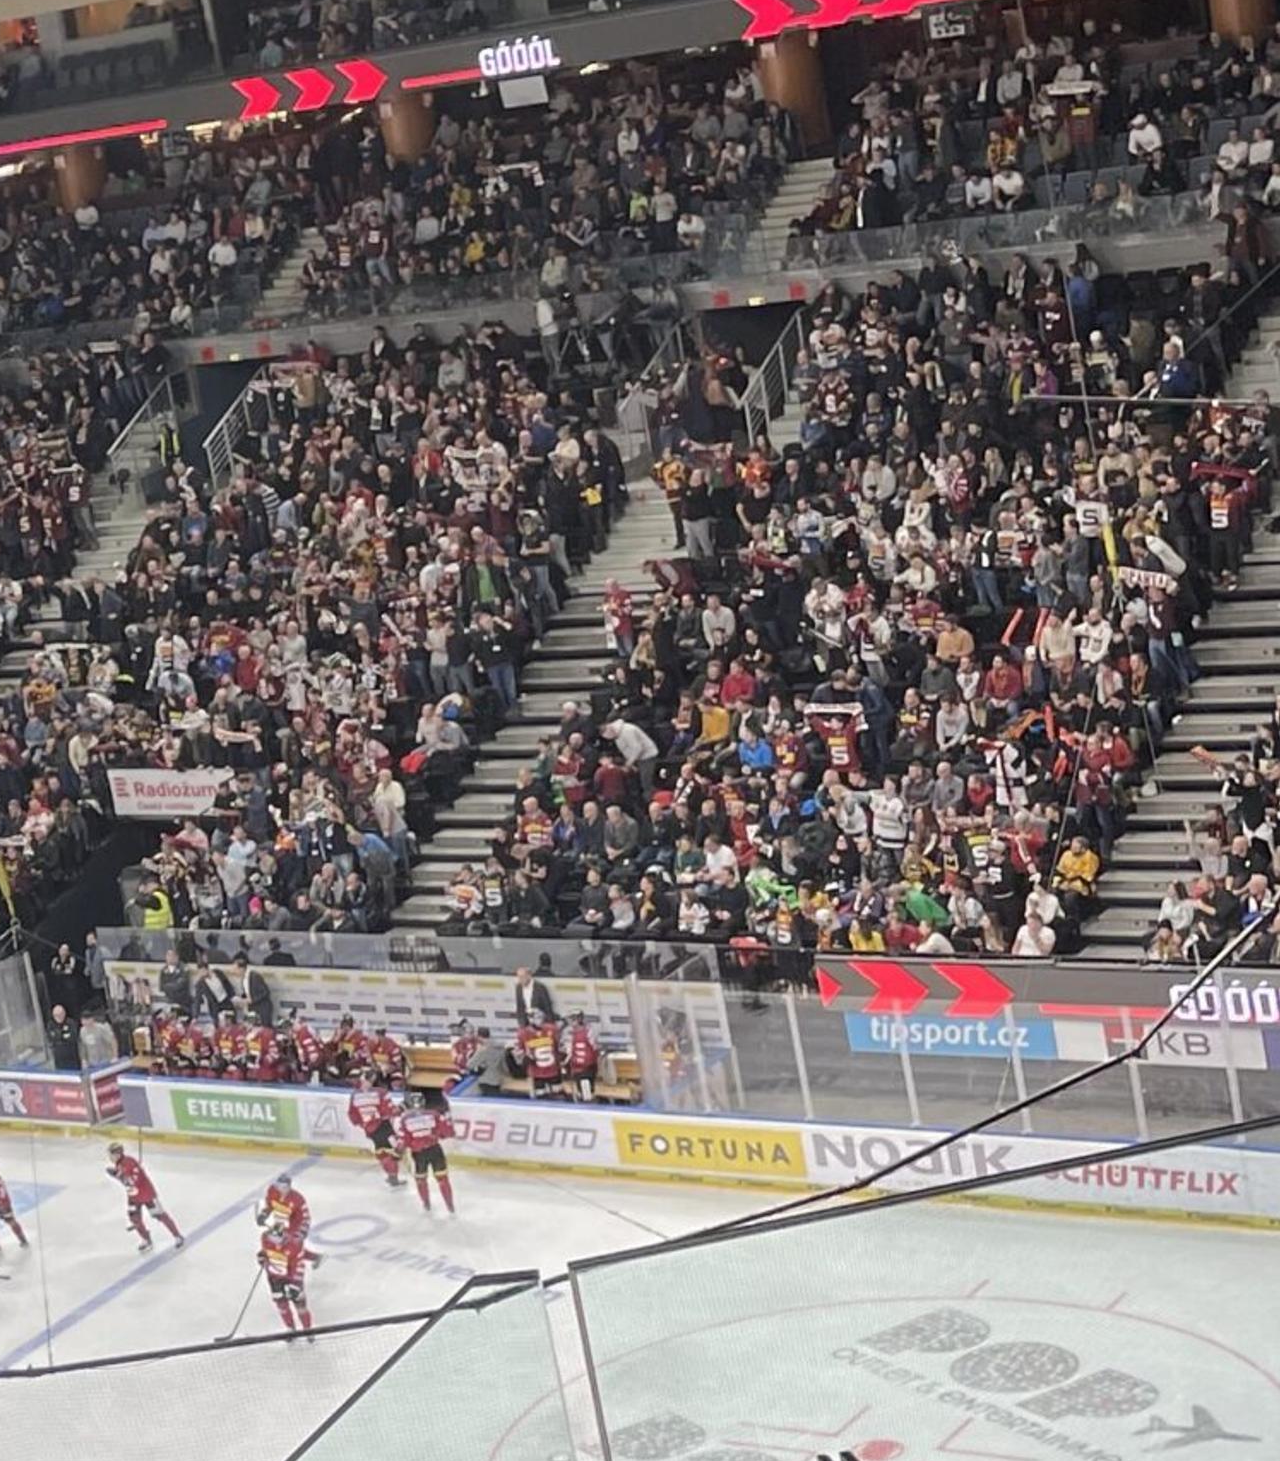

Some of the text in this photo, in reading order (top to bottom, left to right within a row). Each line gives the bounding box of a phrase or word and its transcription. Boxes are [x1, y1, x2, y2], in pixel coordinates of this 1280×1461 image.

[478, 36, 561, 78] GÓÓÓL
[134, 780, 218, 798] Radiožurn
[1169, 978, 1280, 1023] GÓÓÓ
[870, 1014, 1030, 1050] tipsport.cz
[1157, 1031, 1211, 1056] KB
[186, 1099, 277, 1122] ETERNAL
[629, 1133, 791, 1165] FORTUNA
